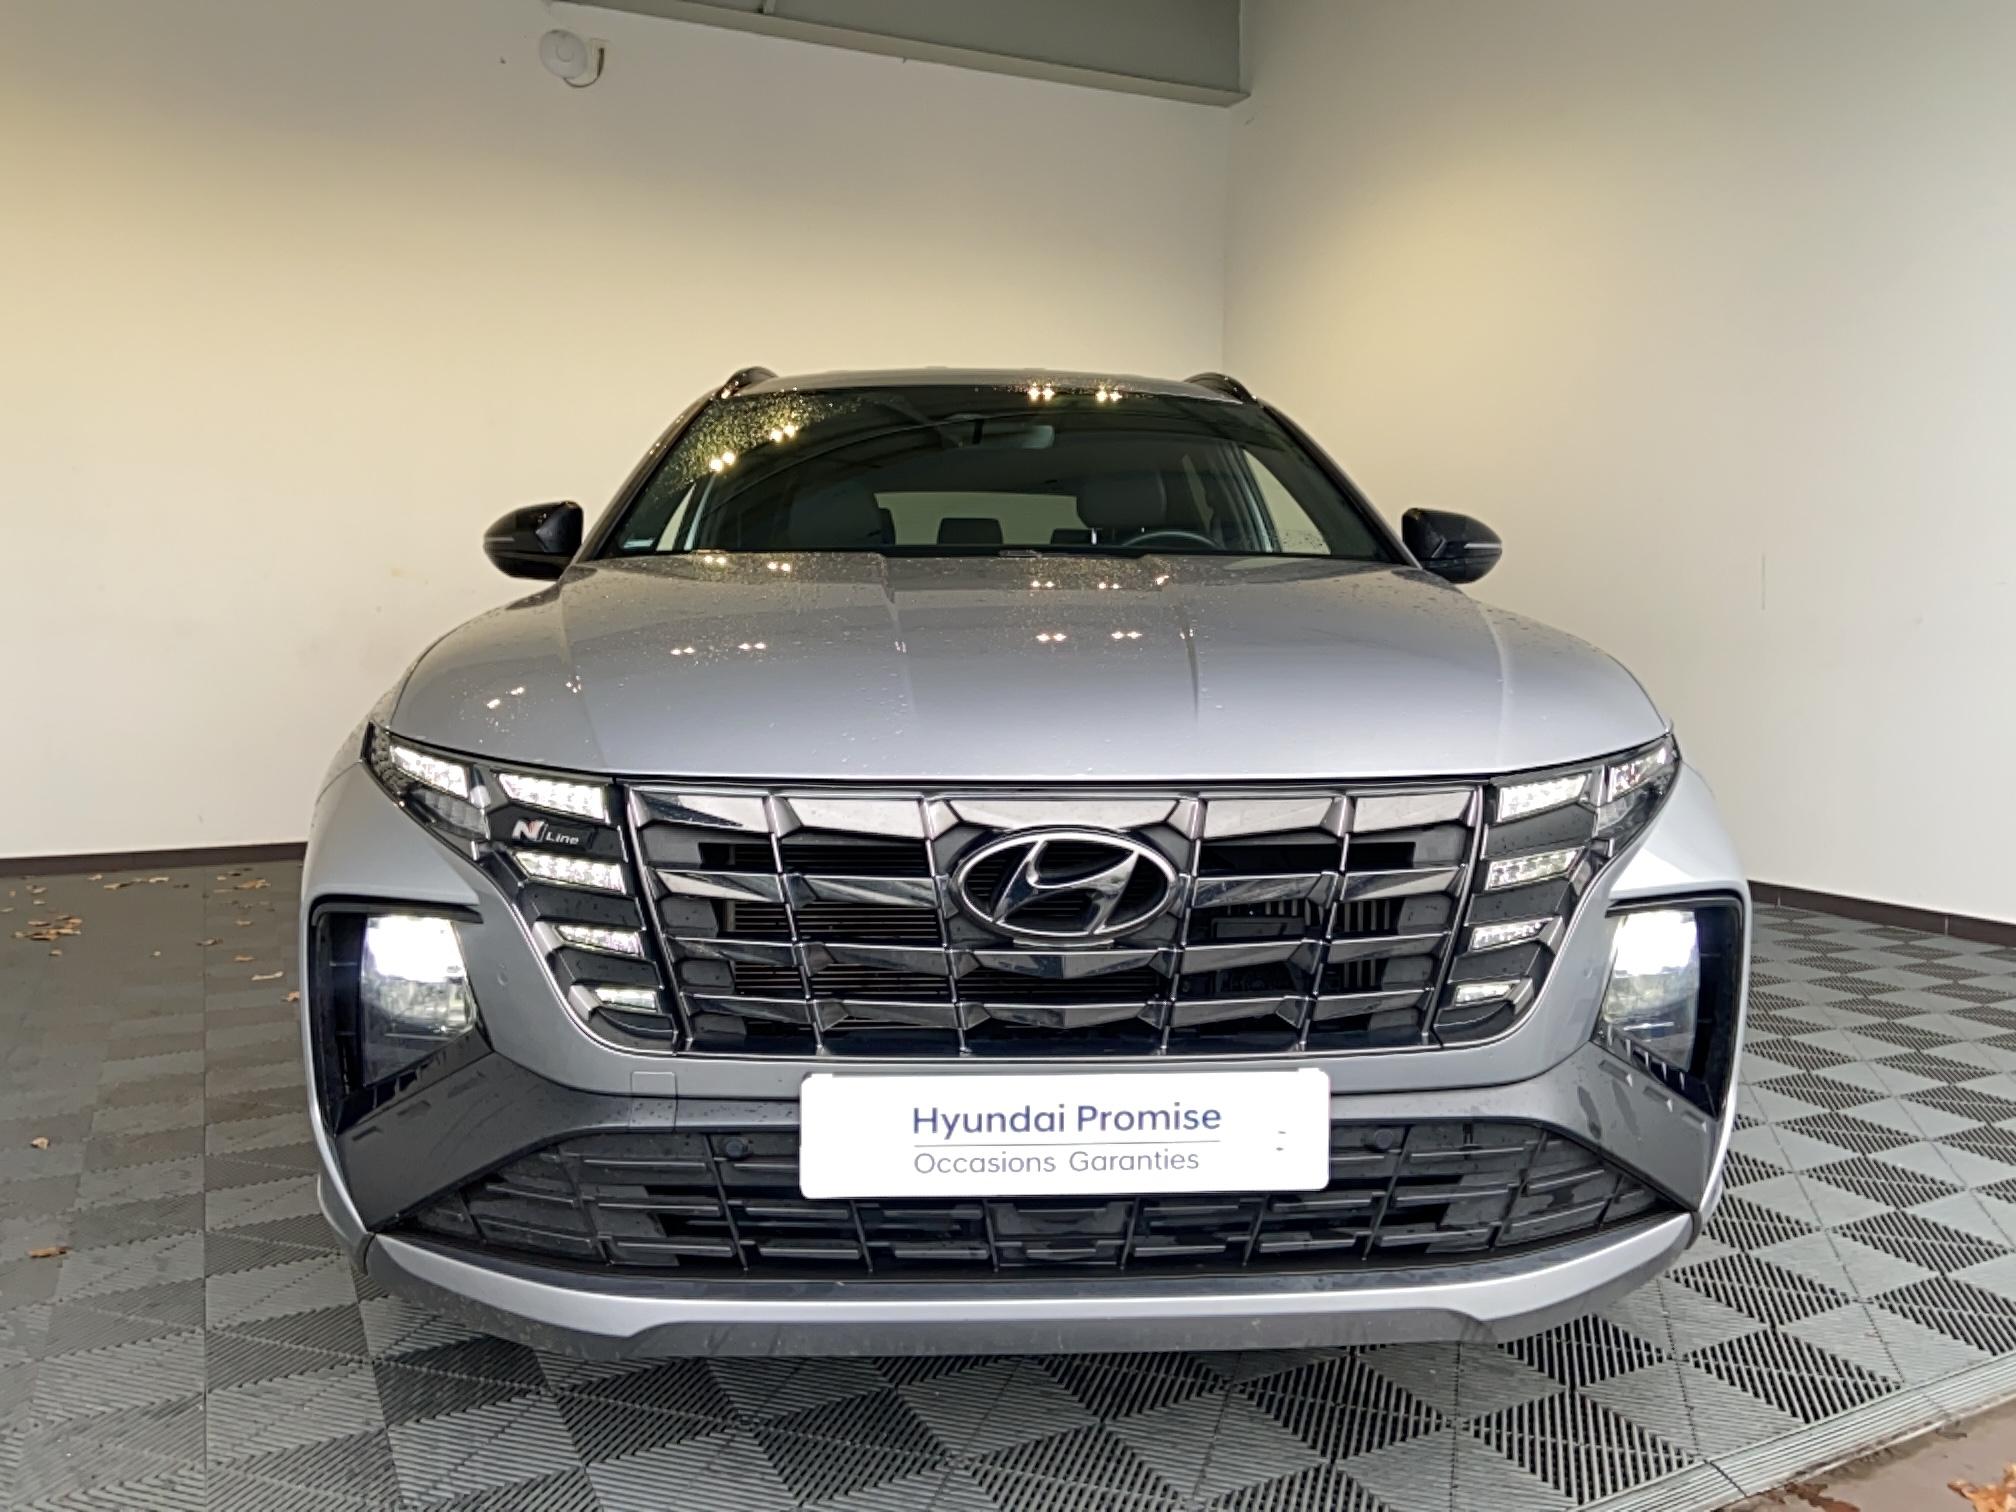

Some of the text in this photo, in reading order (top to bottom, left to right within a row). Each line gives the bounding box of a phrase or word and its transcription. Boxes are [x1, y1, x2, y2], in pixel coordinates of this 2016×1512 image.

[546, 831, 579, 845] Line
[912, 1102, 1222, 1140] Hyundai Promise
[913, 1147, 1200, 1174] Occasions Garanties
